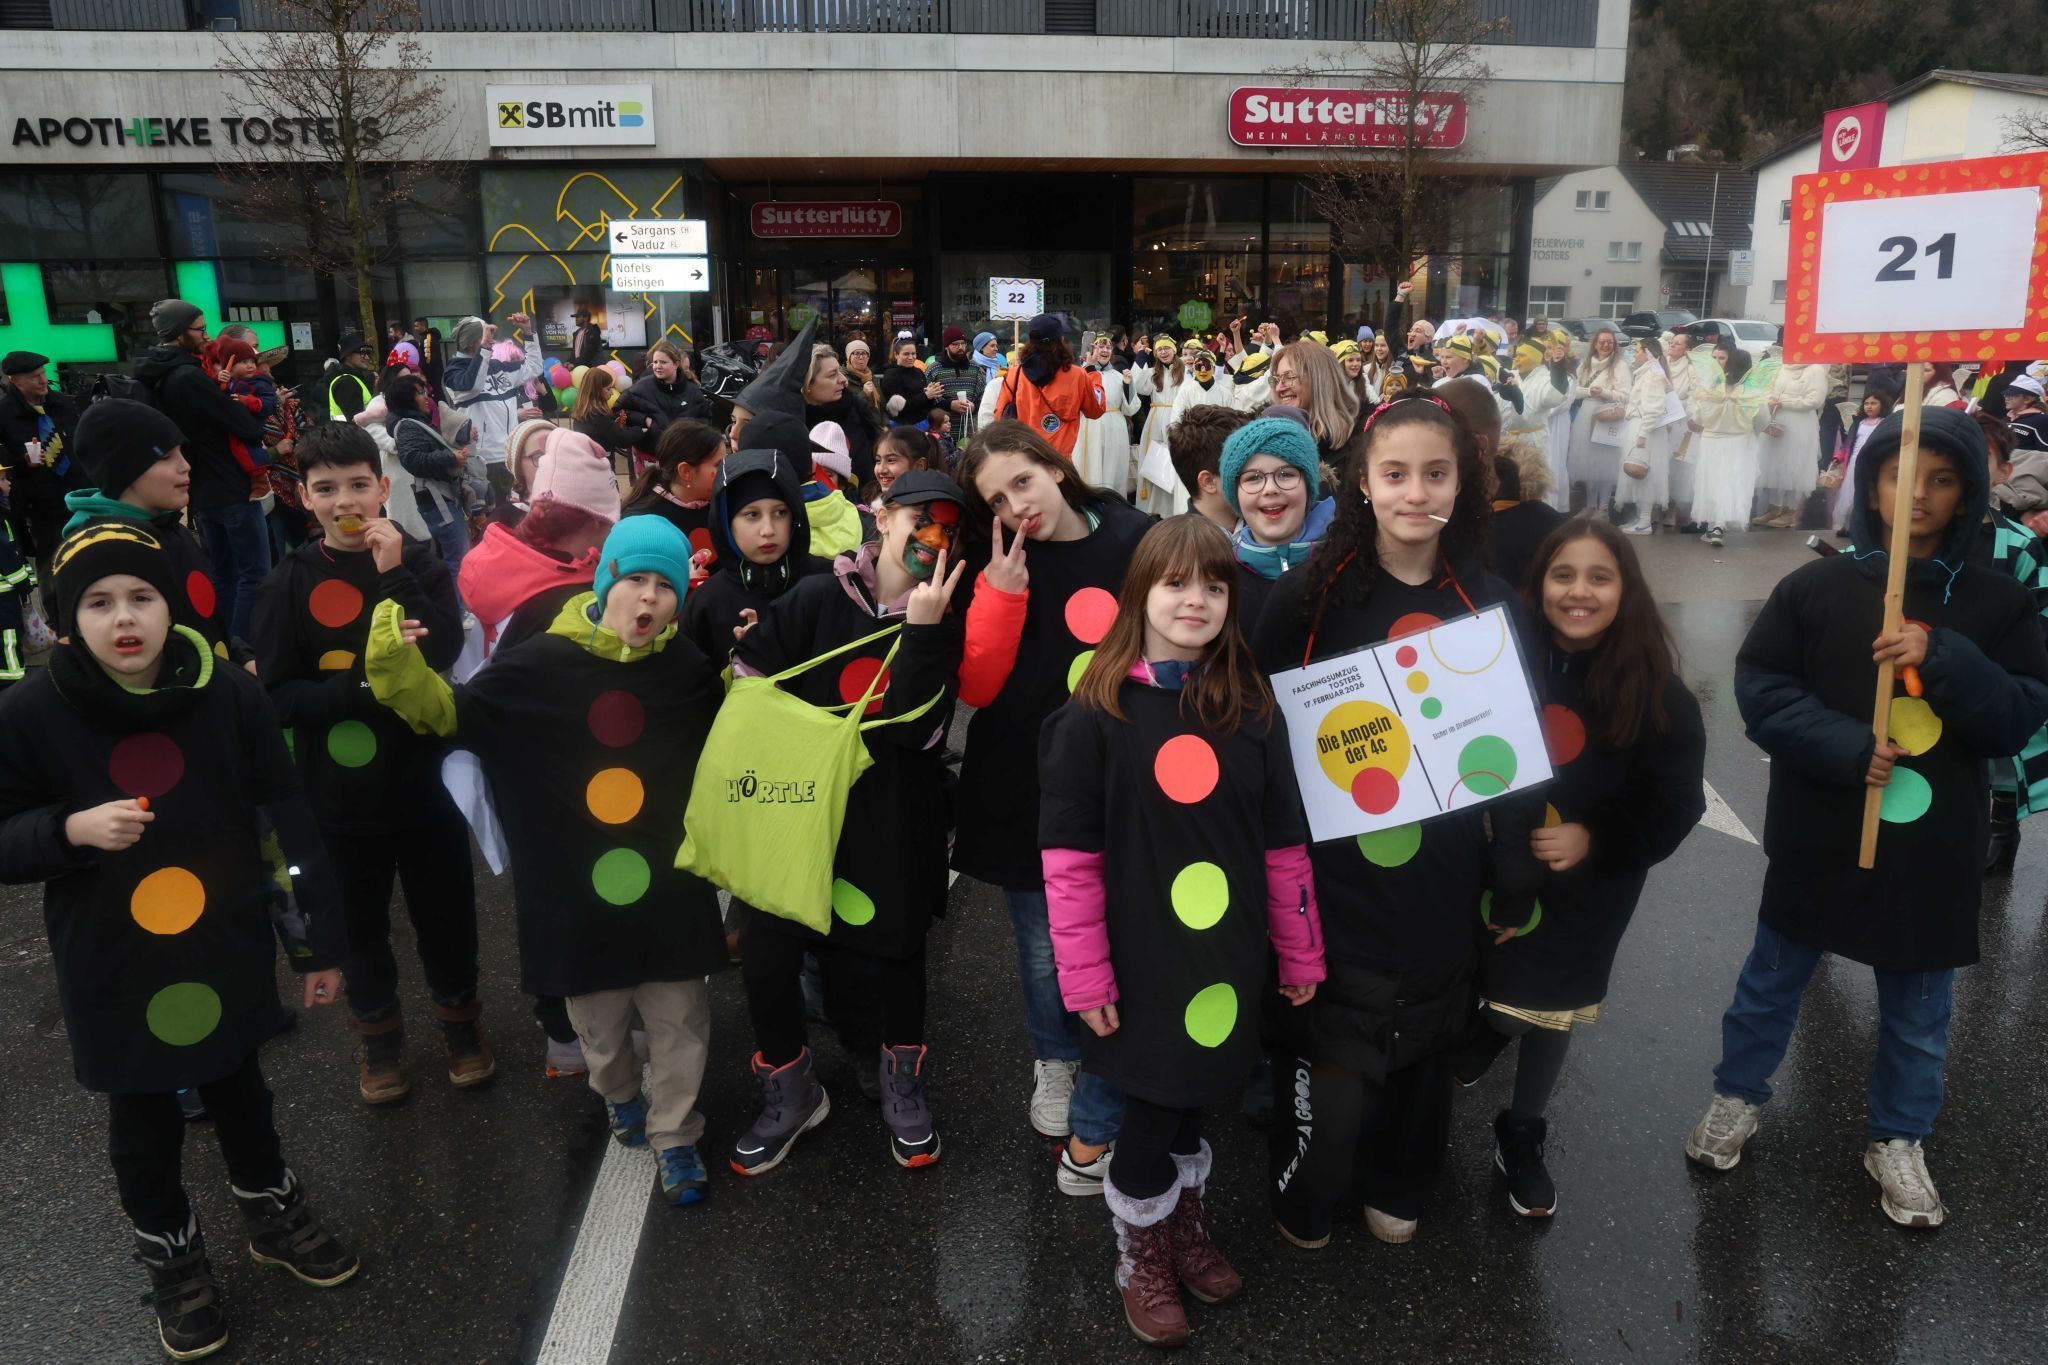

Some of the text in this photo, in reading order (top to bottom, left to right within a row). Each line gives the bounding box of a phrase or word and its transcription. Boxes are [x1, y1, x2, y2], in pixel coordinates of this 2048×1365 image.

[1244, 94, 1453, 132] Sutterlüty
[12, 117, 212, 147] APOTHEKE
[1246, 131, 1288, 140] MEIN
[761, 207, 892, 227] Sutterlüty
[631, 225, 676, 238] Sargans
[632, 240, 665, 250] Vaduz
[1533, 238, 1585, 248] FEUERWEHR
[1533, 250, 1570, 260] TOSTERS
[1874, 232, 1956, 282] 21
[616, 263, 651, 273] Nofels
[617, 276, 665, 289] Gisingen
[1008, 292, 1025, 304] 22
[1292, 665, 1358, 695] FASCHINGSUMZUG
[1329, 673, 1361, 690] TOSTERS
[1313, 688, 1345, 706] FEBRUAR
[1344, 682, 1365, 694] 2026
[1317, 716, 1392, 754] Die Ampeln
[1344, 744, 1368, 765] der
[725, 769, 815, 804] HÖRTLE
[1294, 1068, 1313, 1121] GOOD
[1296, 1125, 1313, 1141] A
